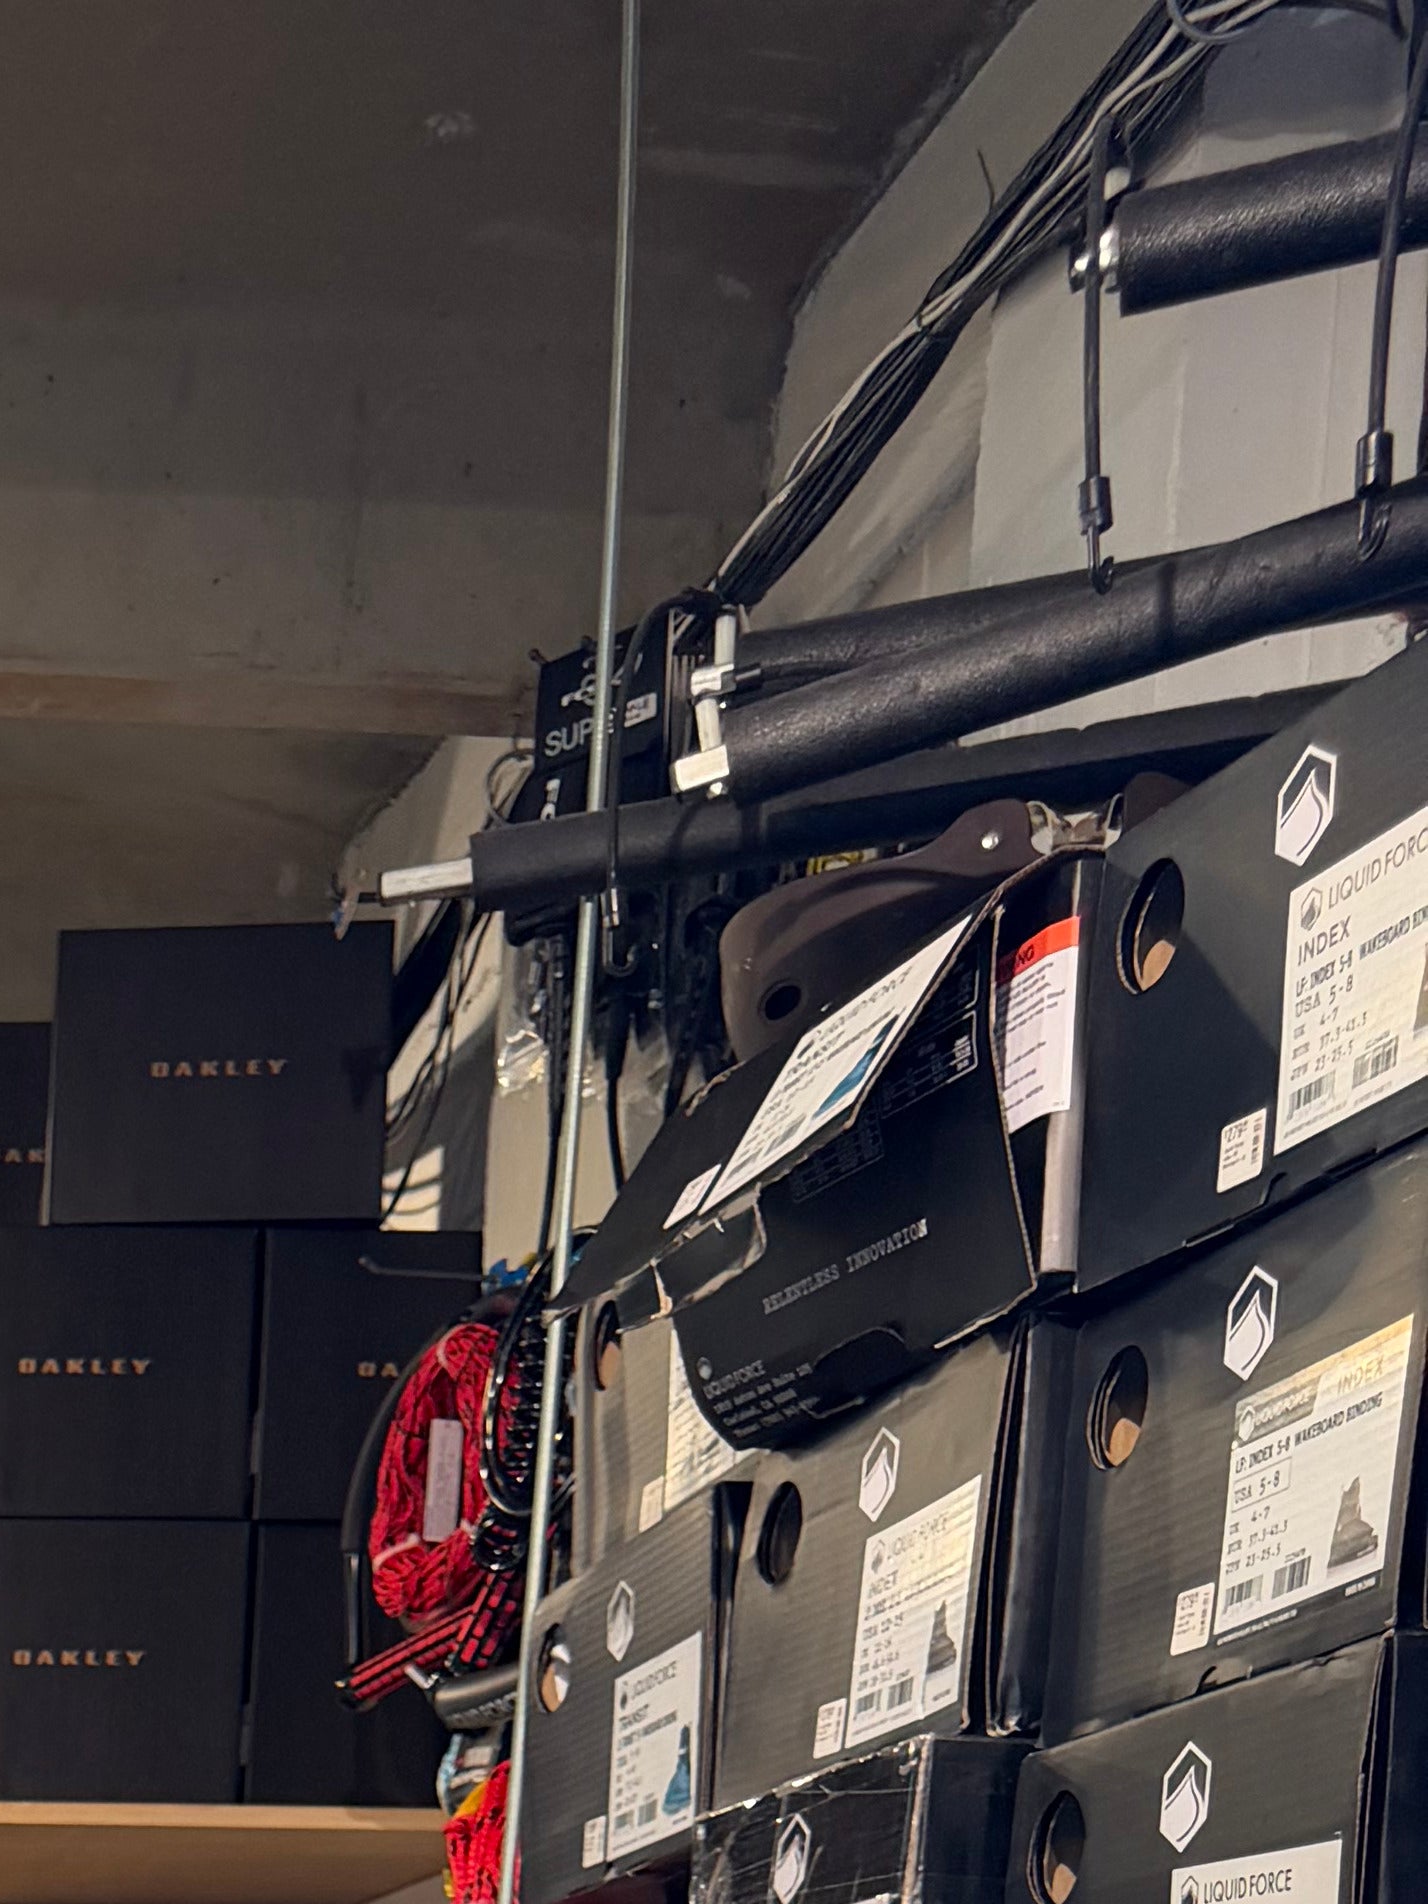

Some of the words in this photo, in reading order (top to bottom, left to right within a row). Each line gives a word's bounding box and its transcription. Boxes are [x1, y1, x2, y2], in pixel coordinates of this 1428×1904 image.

[1298, 915, 1351, 966] INDEX
[1295, 991, 1321, 1018] USA
[1328, 974, 1354, 1005] 5-8
[150, 1059, 288, 1078] OAKLEY
[846, 1218, 929, 1273] INNOVATION
[18, 1358, 151, 1375] OAKLEY
[1294, 1410, 1345, 1447] WAKEBOARD
[1259, 1470, 1280, 1497] 5-8
[12, 1649, 147, 1666] OAKLEY
[1203, 1877, 1246, 1904] LIQUID
[1249, 1869, 1293, 1896] FORCE
